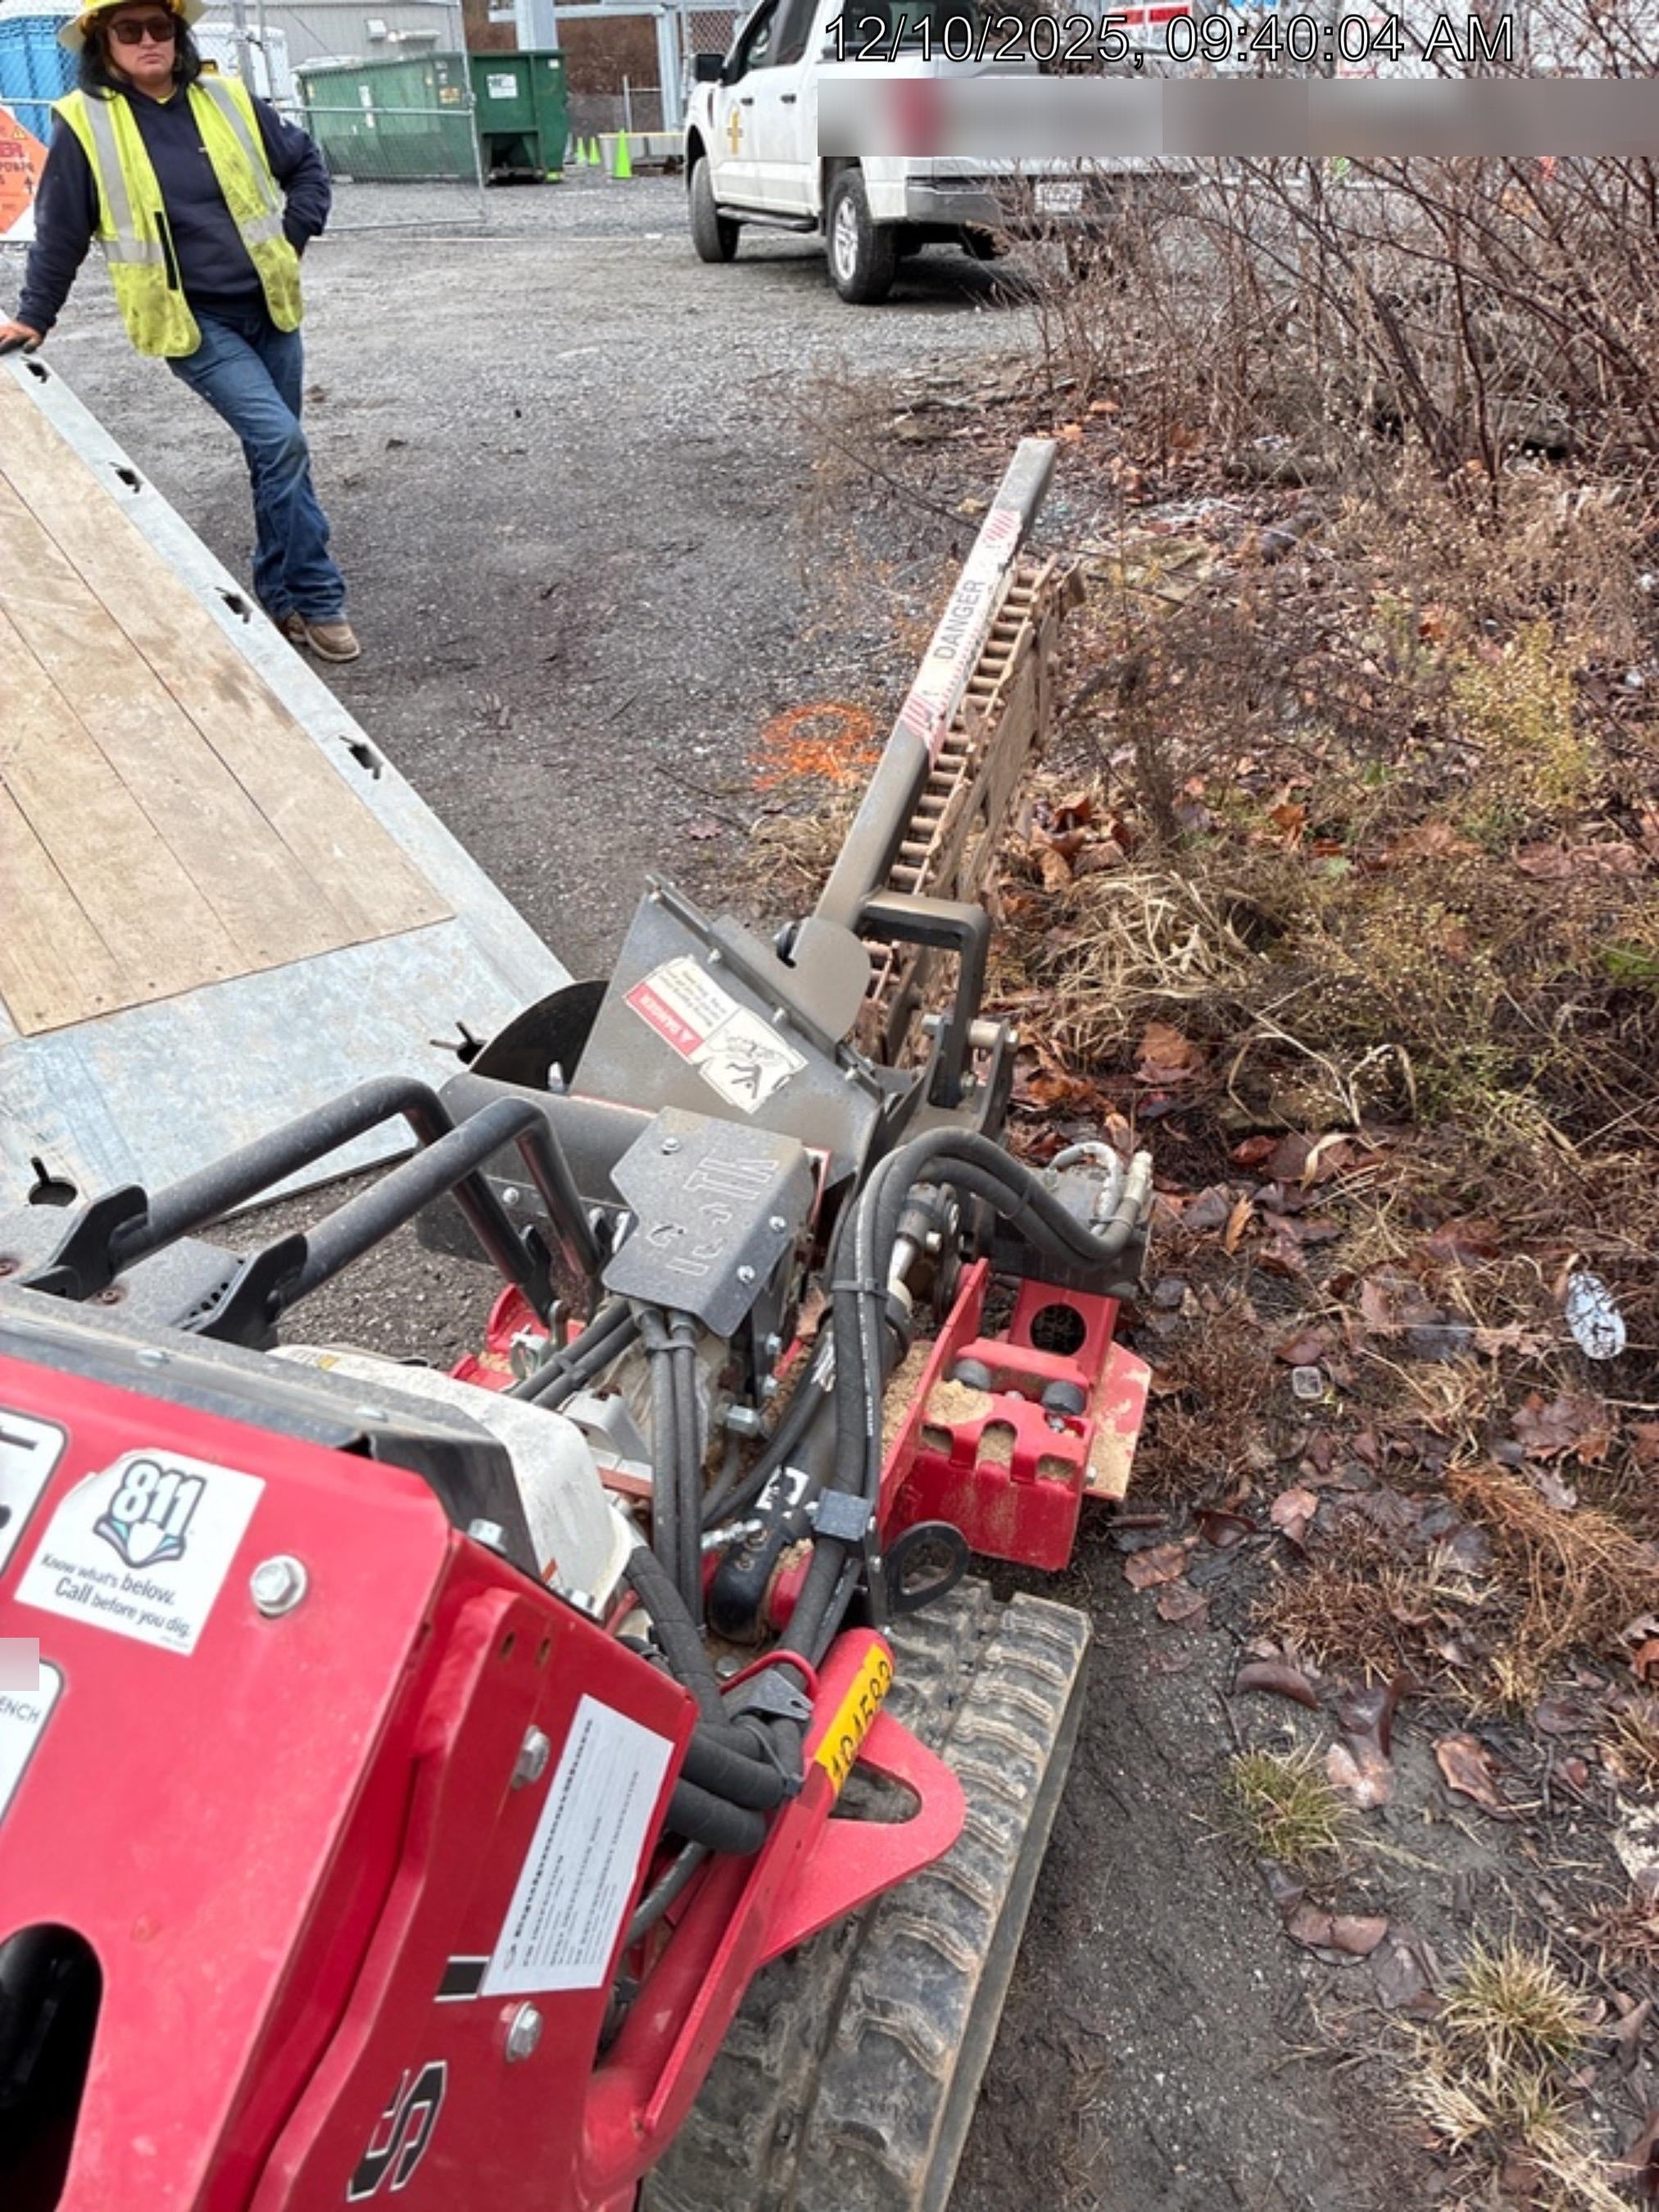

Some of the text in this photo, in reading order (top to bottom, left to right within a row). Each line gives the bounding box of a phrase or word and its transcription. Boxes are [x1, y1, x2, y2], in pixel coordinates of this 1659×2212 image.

[933, 579, 986, 660] DANGER
[109, 1458, 207, 1535] 811
[40, 1553, 176, 1606] Know what's below.
[55, 1576, 94, 1604] Call
[91, 1593, 138, 1620] before
[137, 1608, 165, 1626] you
